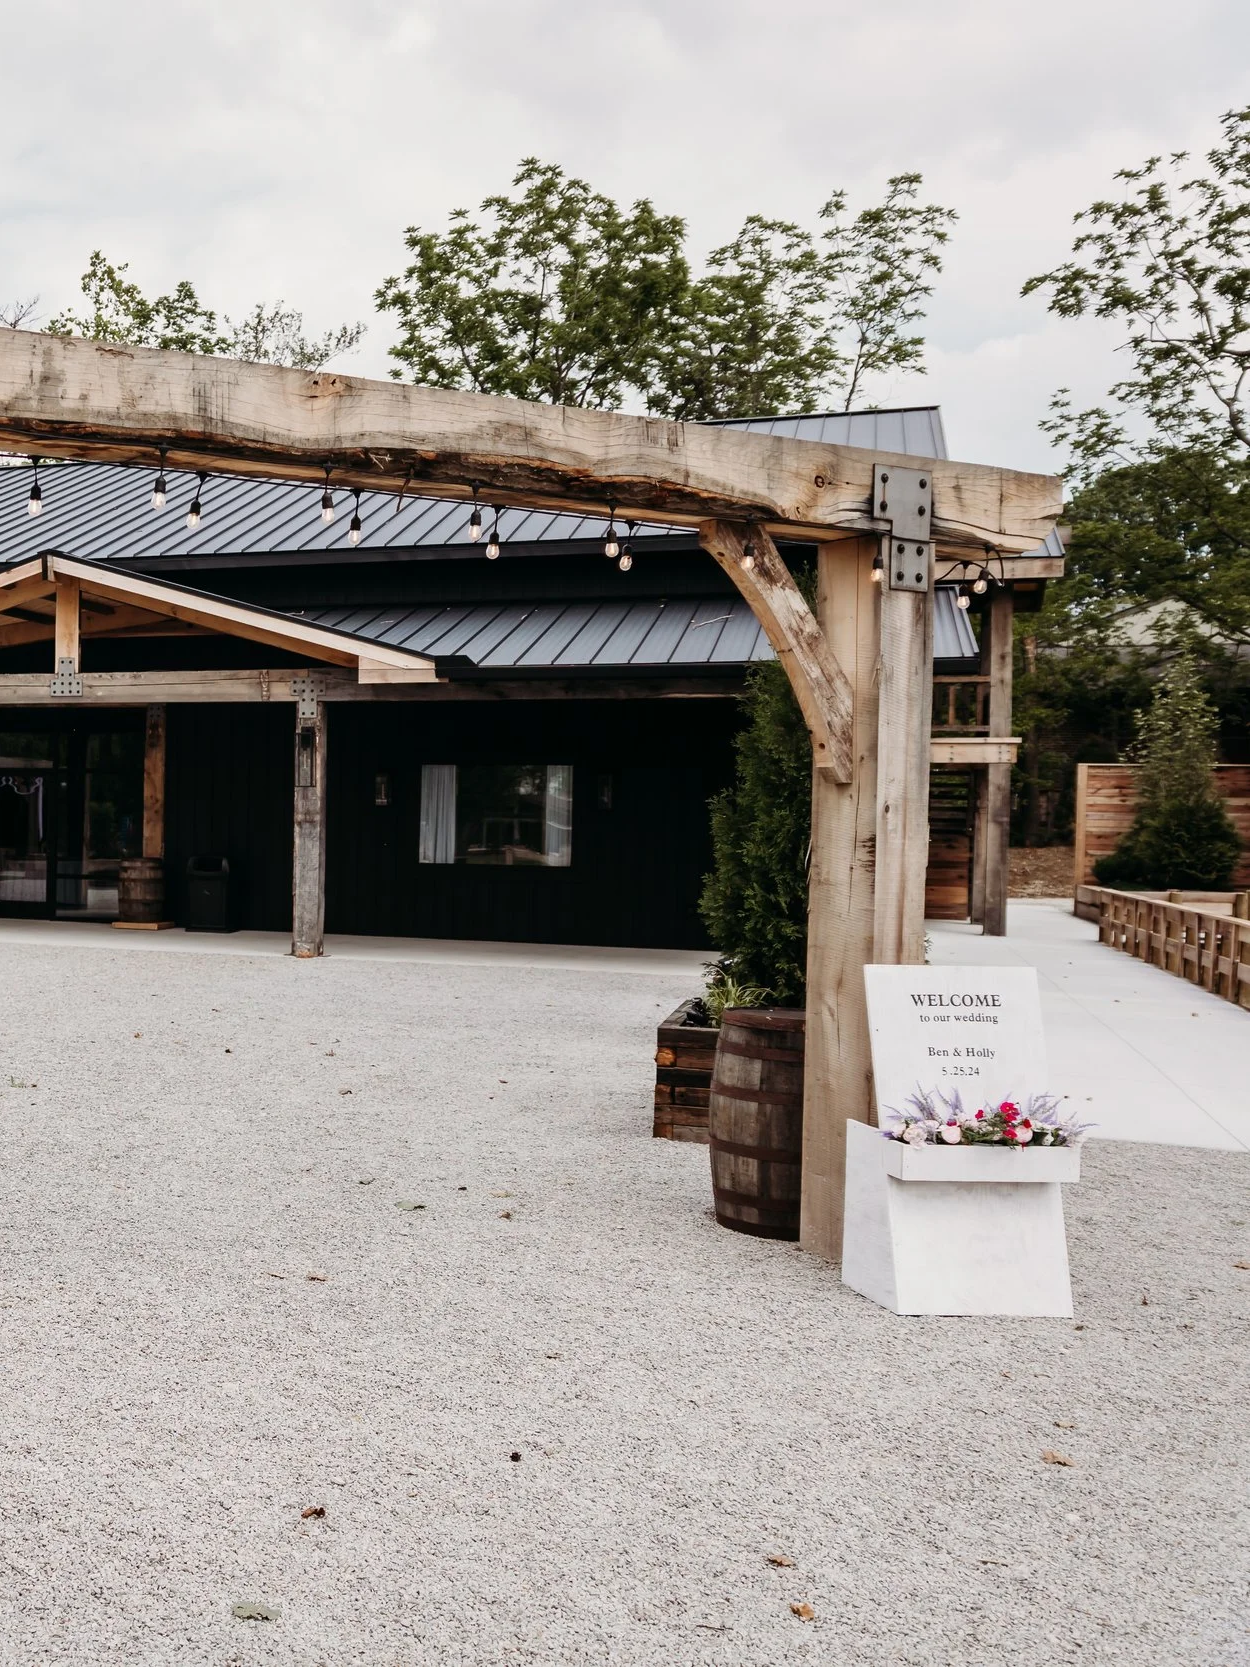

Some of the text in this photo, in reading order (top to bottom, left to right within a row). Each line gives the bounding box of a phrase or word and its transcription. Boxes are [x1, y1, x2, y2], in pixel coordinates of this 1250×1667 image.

[910, 993, 1002, 1008] WELCOME
[919, 1012, 999, 1025] to our wedding
[927, 1046, 996, 1060] Ben & Holly
